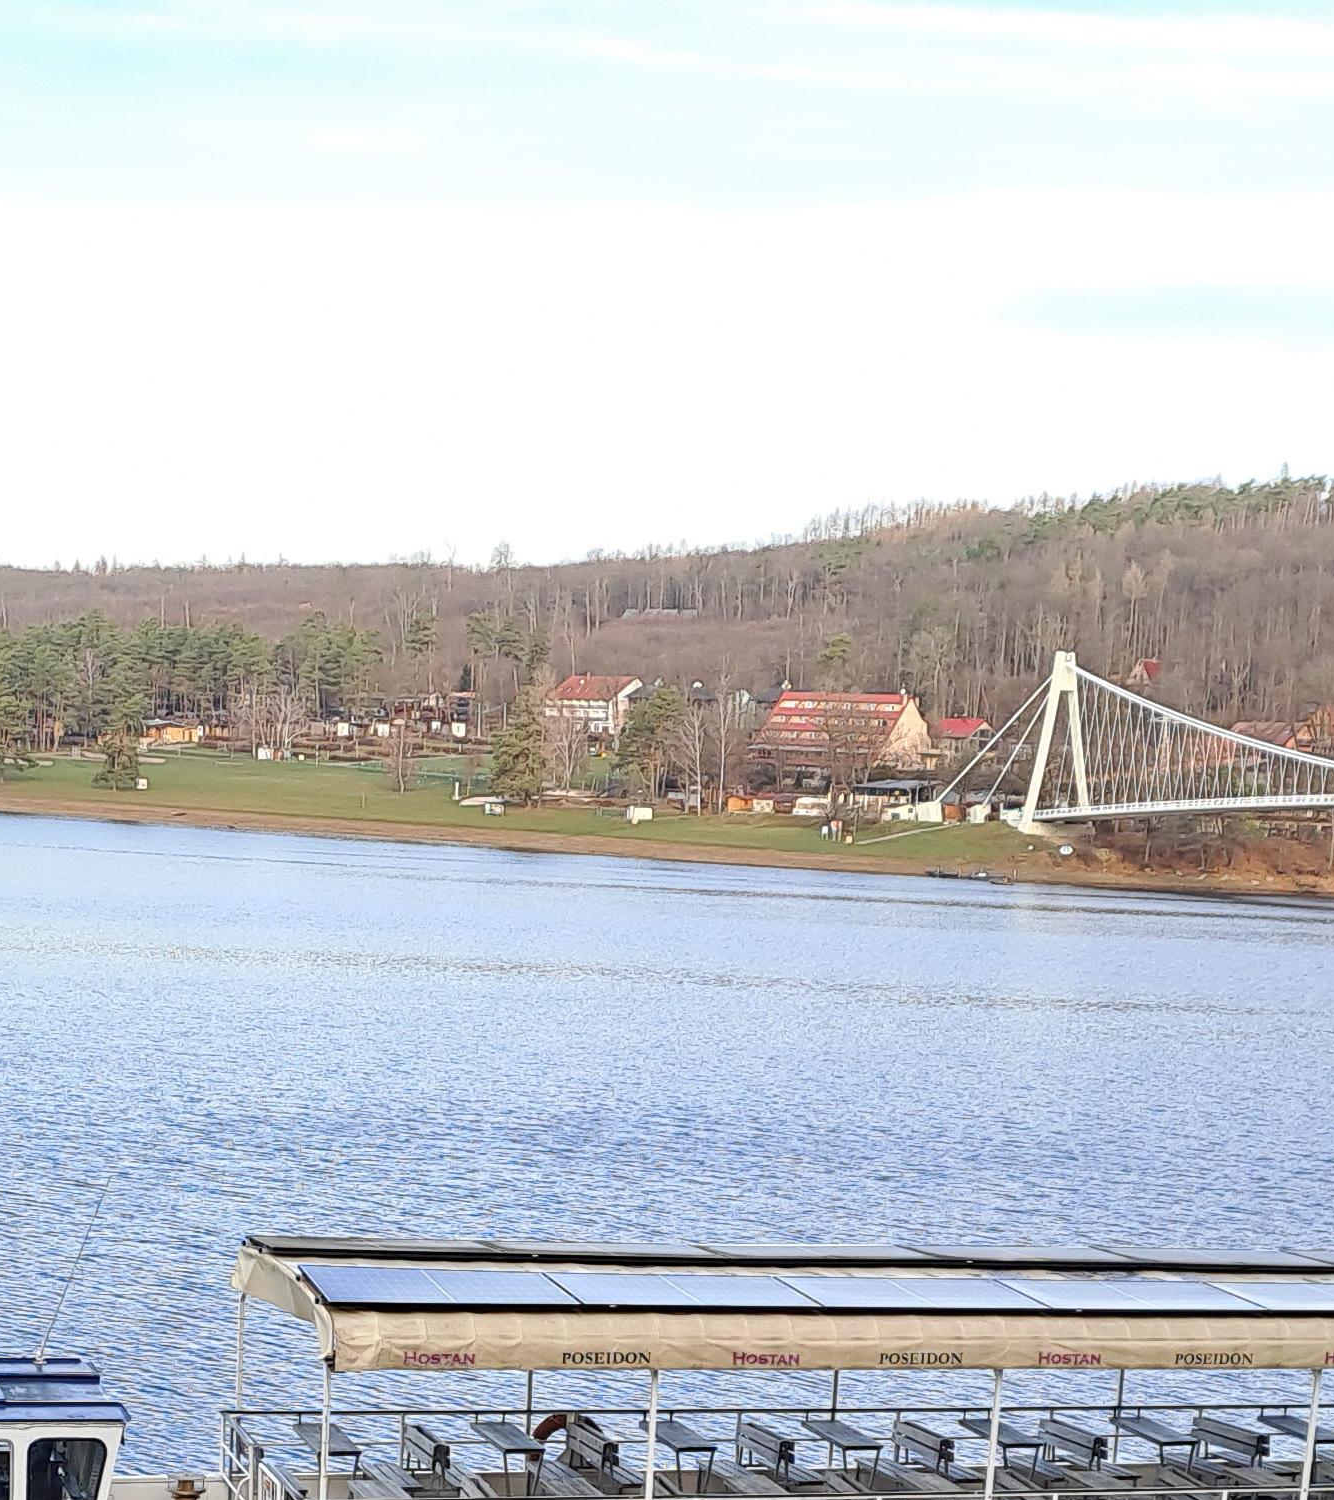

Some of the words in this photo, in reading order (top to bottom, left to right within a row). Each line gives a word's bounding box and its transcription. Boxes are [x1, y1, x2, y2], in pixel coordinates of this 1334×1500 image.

[562, 1350, 652, 1365] POSEIDON
[879, 1351, 964, 1365] POSEIDON
[1174, 1352, 1254, 1365] POSEIDON
